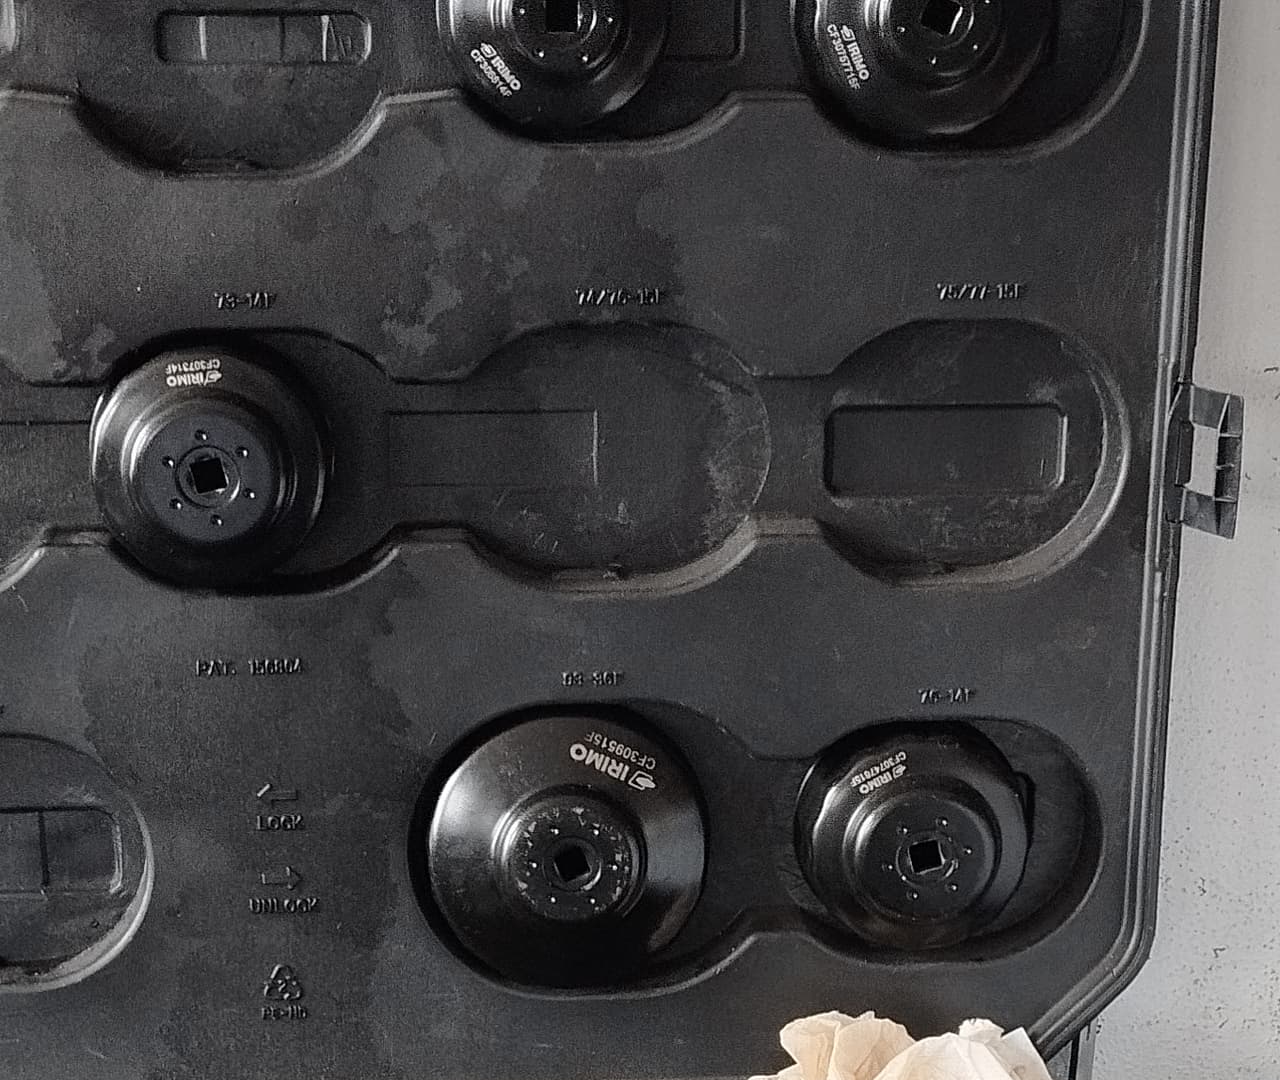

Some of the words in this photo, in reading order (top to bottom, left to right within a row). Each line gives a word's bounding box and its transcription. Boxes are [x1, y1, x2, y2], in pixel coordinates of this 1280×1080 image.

[490, 56, 521, 91] IRIMO
[848, 42, 870, 81] IRIMO
[166, 371, 204, 387] IRIMO
[569, 743, 629, 781] IRIMO
[584, 731, 656, 770] CF309515F
[859, 770, 893, 794] IRIMO
[255, 815, 303, 830] LOCK
[249, 898, 319, 913] UNLOCK
